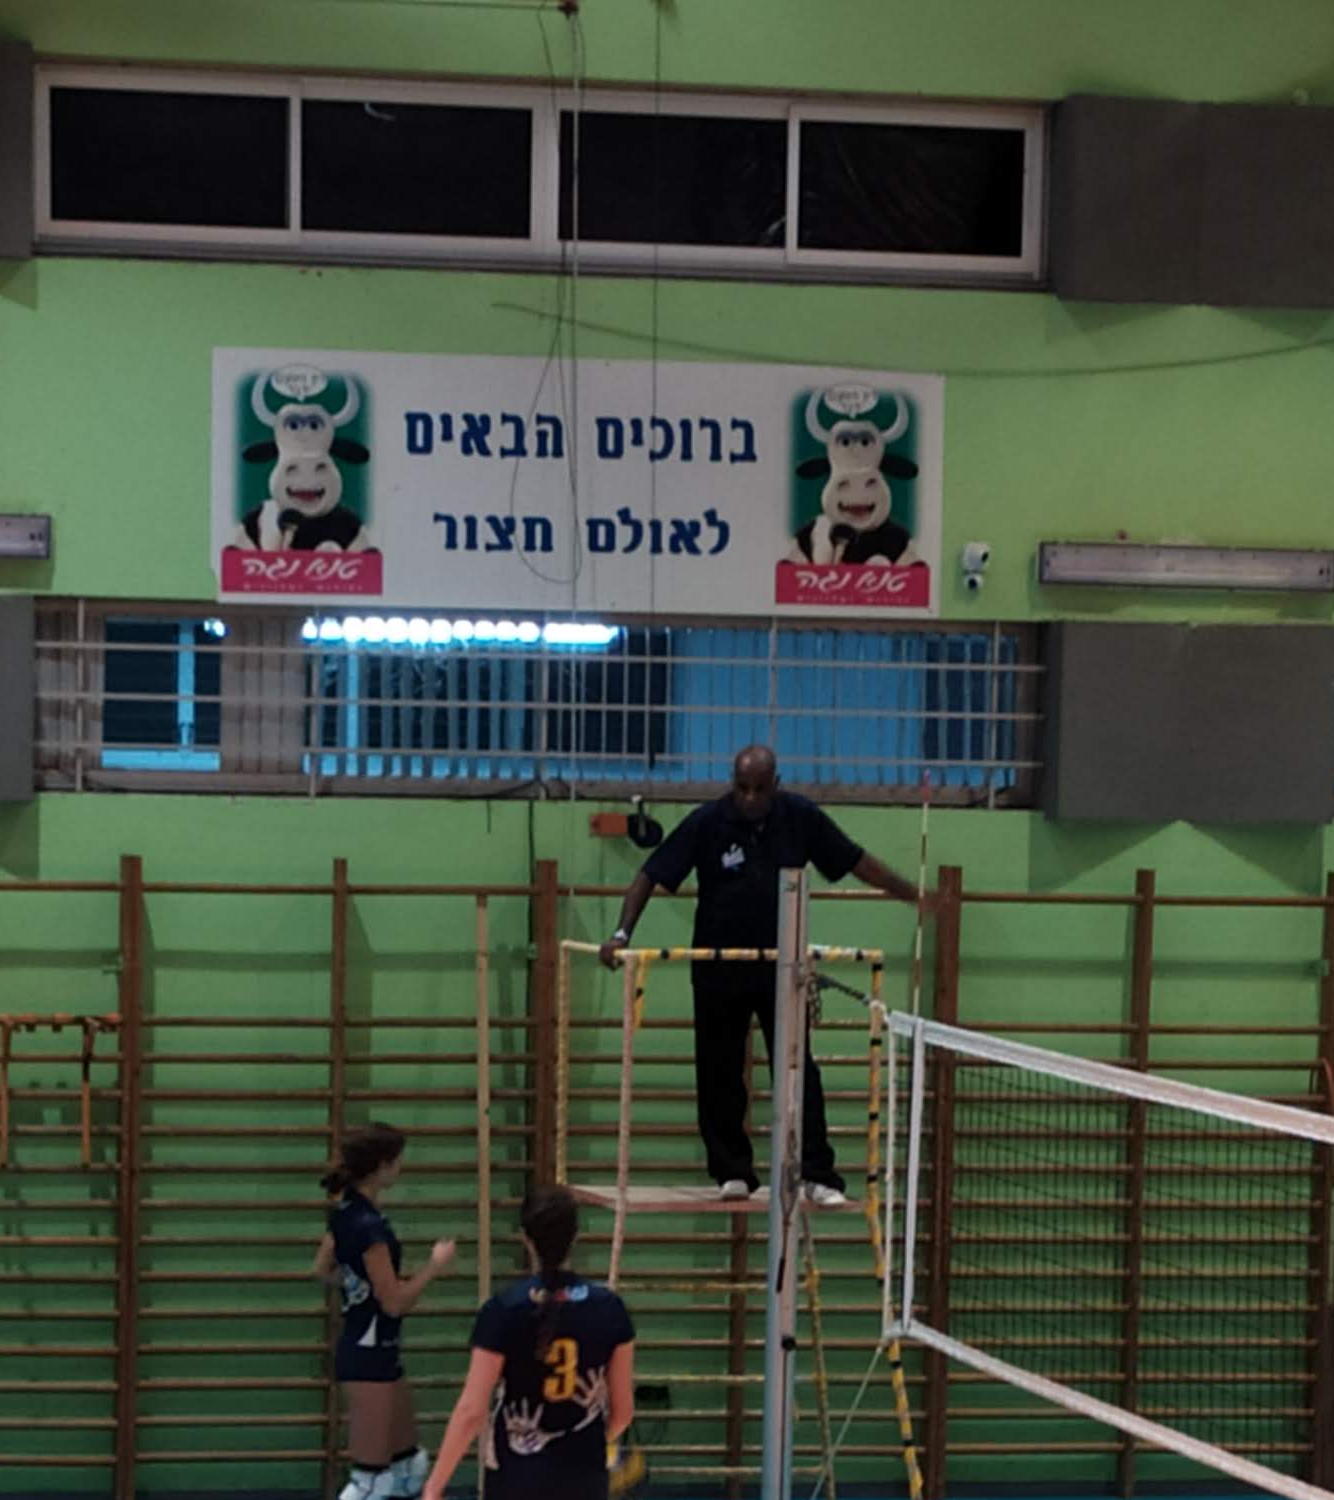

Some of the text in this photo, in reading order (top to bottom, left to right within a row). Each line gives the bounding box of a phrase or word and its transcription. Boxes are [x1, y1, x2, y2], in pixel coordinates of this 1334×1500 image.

[404, 412, 758, 463] ברוכים הבאים
[433, 507, 730, 555] לאולם חצור
[543, 1337, 579, 1402] 3
